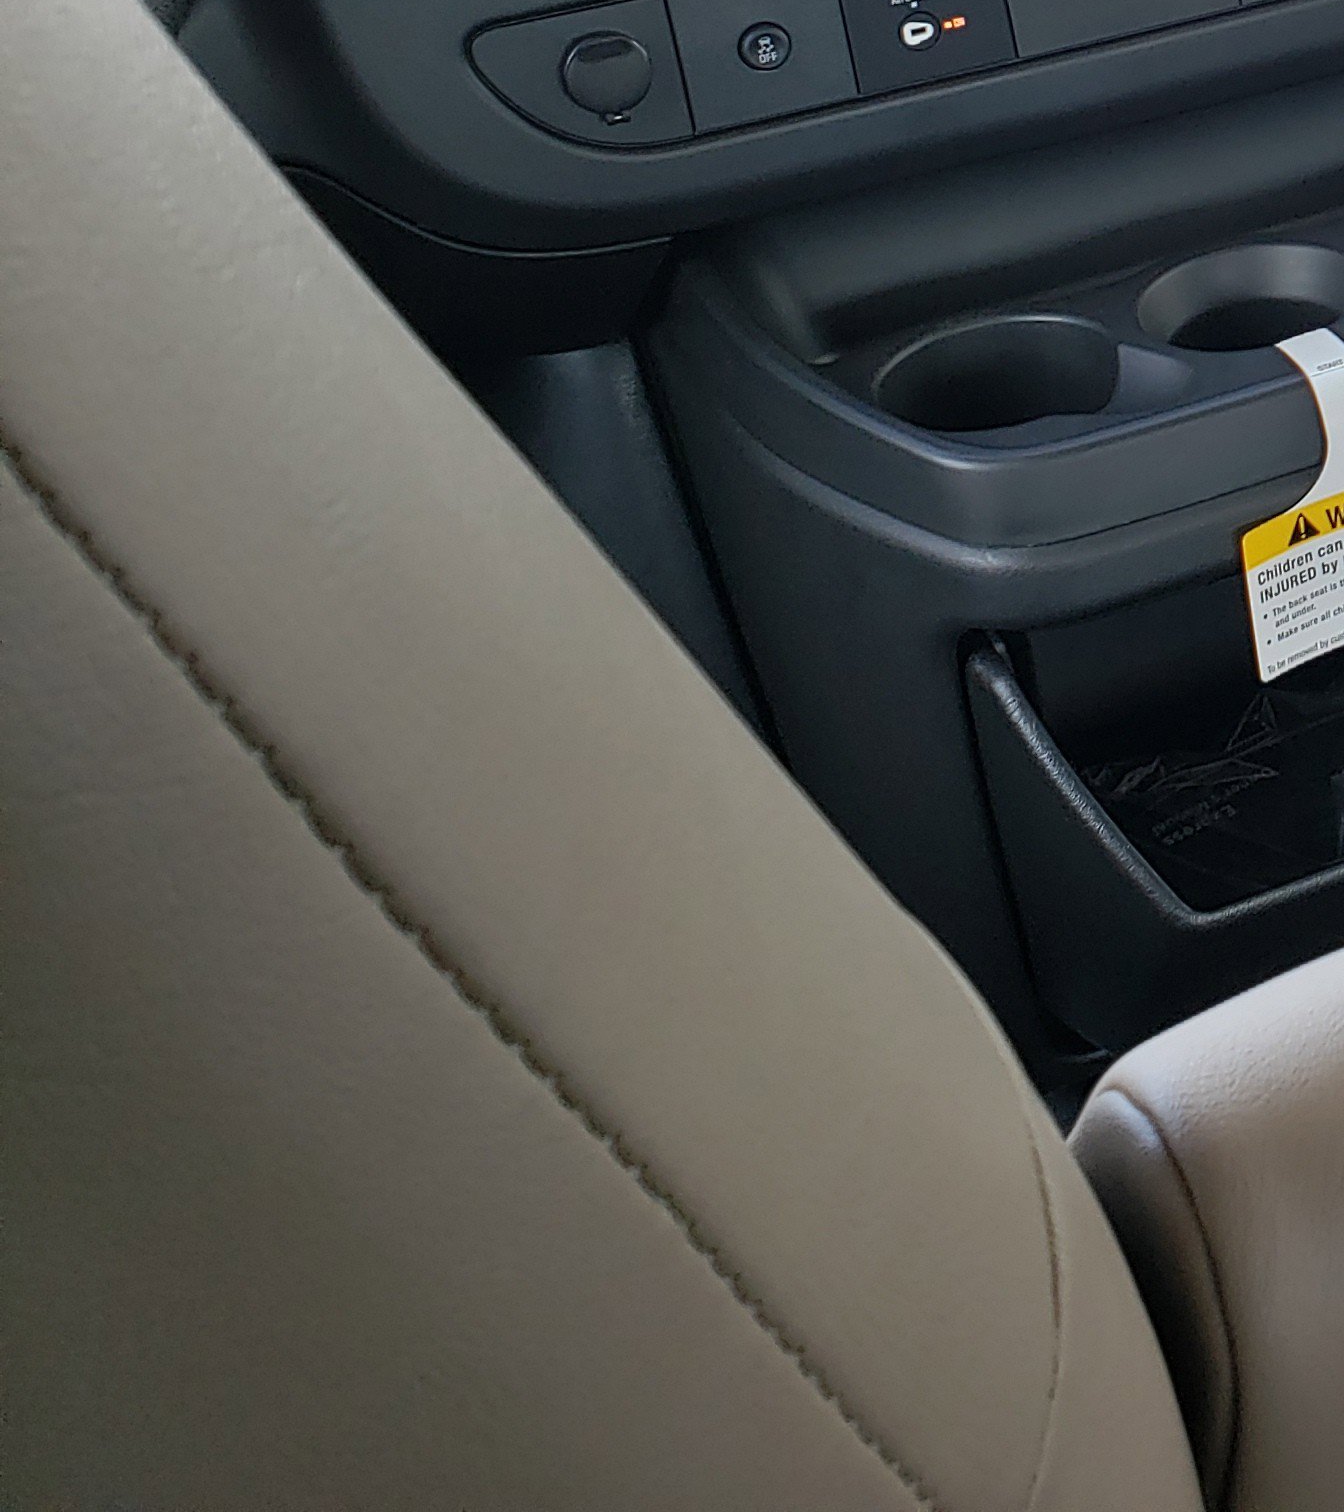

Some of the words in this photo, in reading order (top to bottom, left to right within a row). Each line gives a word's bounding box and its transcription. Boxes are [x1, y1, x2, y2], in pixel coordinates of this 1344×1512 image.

[759, 52, 777, 64] OFF
[1257, 548, 1314, 586] Children
[1317, 538, 1344, 558] can
[1259, 566, 1318, 604] INJURED
[1321, 557, 1338, 575] by
[1272, 604, 1288, 618] The
[1288, 594, 1308, 610] back
[1310, 588, 1328, 600] seat
[1330, 582, 1338, 592] is
[1275, 615, 1290, 628] and
[1292, 604, 1317, 621] under.
[1277, 626, 1299, 642] Make
[1301, 618, 1318, 630] sure
[1320, 611, 1332, 623] all
[1267, 664, 1276, 675] To
[1276, 659, 1286, 670] be
[1320, 638, 1330, 650] by
